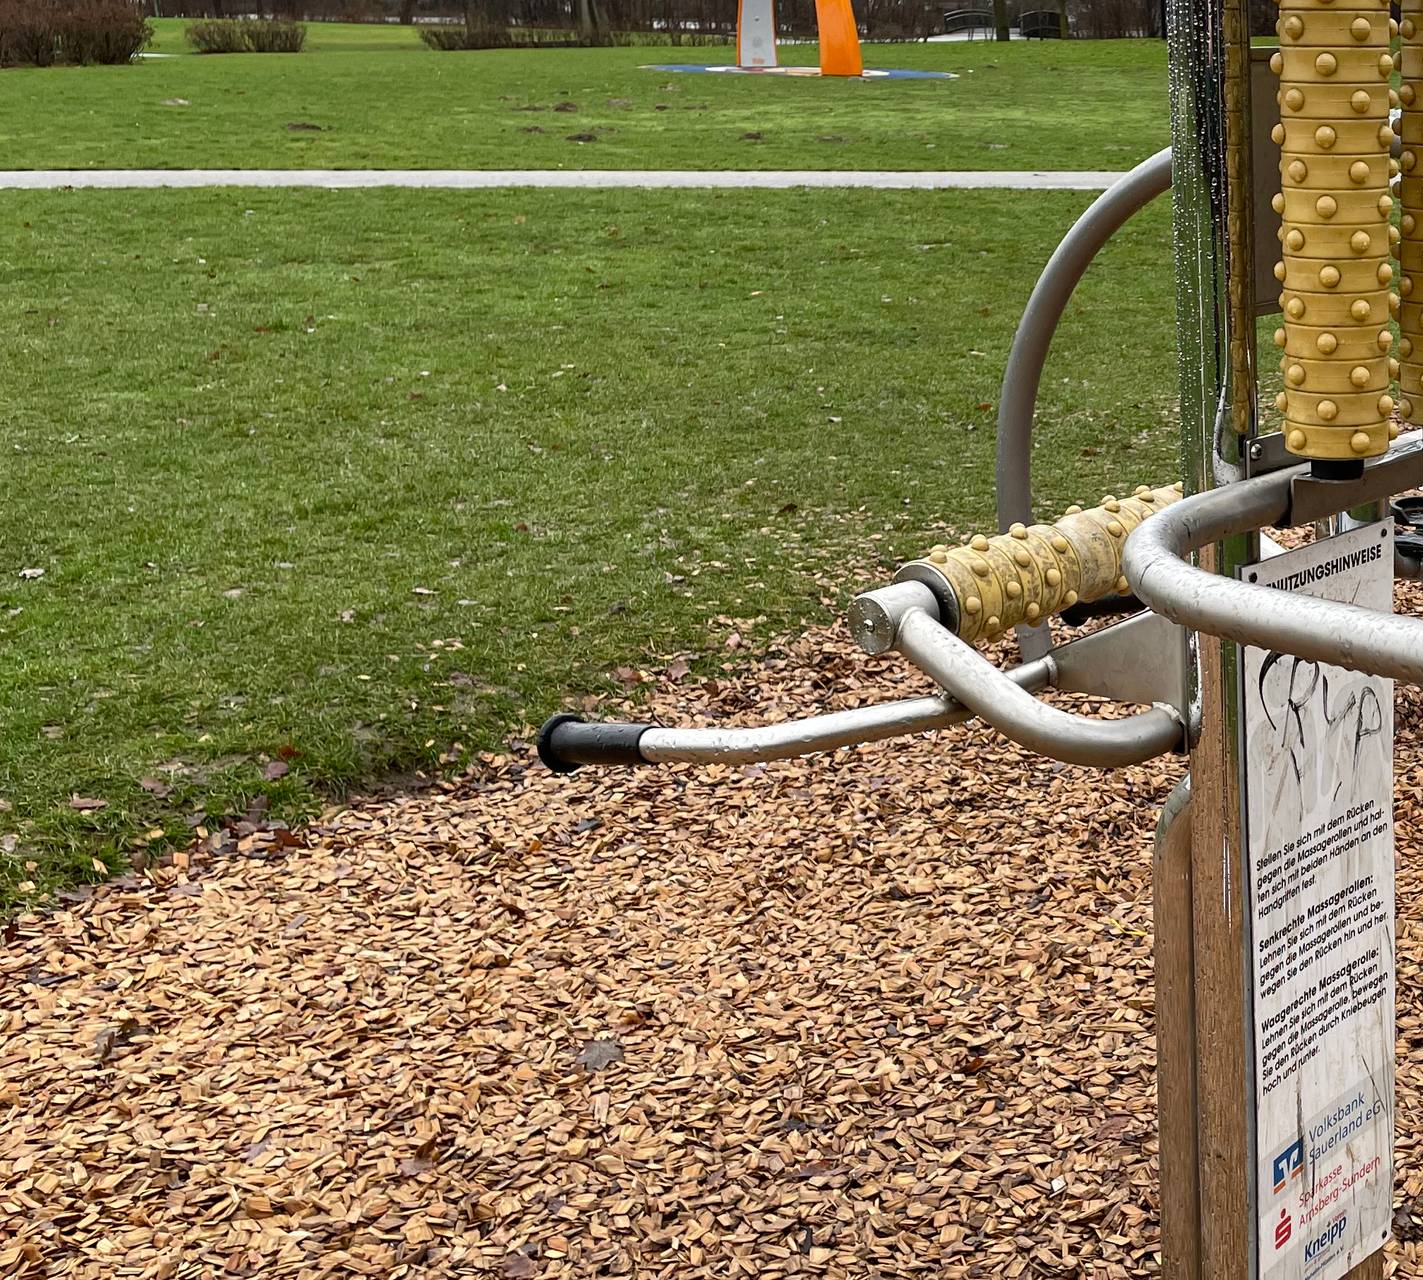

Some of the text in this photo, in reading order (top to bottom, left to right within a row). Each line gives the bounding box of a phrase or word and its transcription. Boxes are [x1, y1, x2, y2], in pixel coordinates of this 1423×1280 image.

[1256, 799, 1374, 871] Stellen Sie sich mit dem Rücken
[1256, 822, 1387, 904] ten sich mit beiden Händen an den
[1257, 807, 1384, 890] gegen die Massagerollen und hal-
[1258, 874, 1374, 952] Senkrechte Massagerollen:
[1259, 887, 1377, 969] Lehnen Sie sich mit dem Rücken
[1259, 900, 1383, 987] gegen die Massagerollen und be-
[1259, 975, 1285, 999] wegen
[1286, 966, 1297, 980] Sie
[1298, 955, 1313, 971] den
[1314, 936, 1342, 961] Rücken
[1343, 928, 1355, 942] hin
[1357, 917, 1372, 934] und
[1260, 946, 1380, 1034] Waagerechte Massagerolle:
[1261, 963, 1377, 1050] Lehnen Sie sich mit dem Rücken
[1261, 1040, 1286, 1068] gegen
[1287, 1030, 1299, 1045] die
[1351, 971, 1388, 1003] bewegen
[1262, 984, 1386, 1081] Sie den Rücken durch Kniebeugen
[1262, 1074, 1281, 1096] hoch
[1282, 1059, 1297, 1079] und
[1308, 1091, 1365, 1142] Volksbank
[1308, 1100, 1381, 1165] Sauerland eG
[1299, 1156, 1380, 1229] Arnsberg-Sundern
[1304, 1216, 1347, 1262] Kneipp
